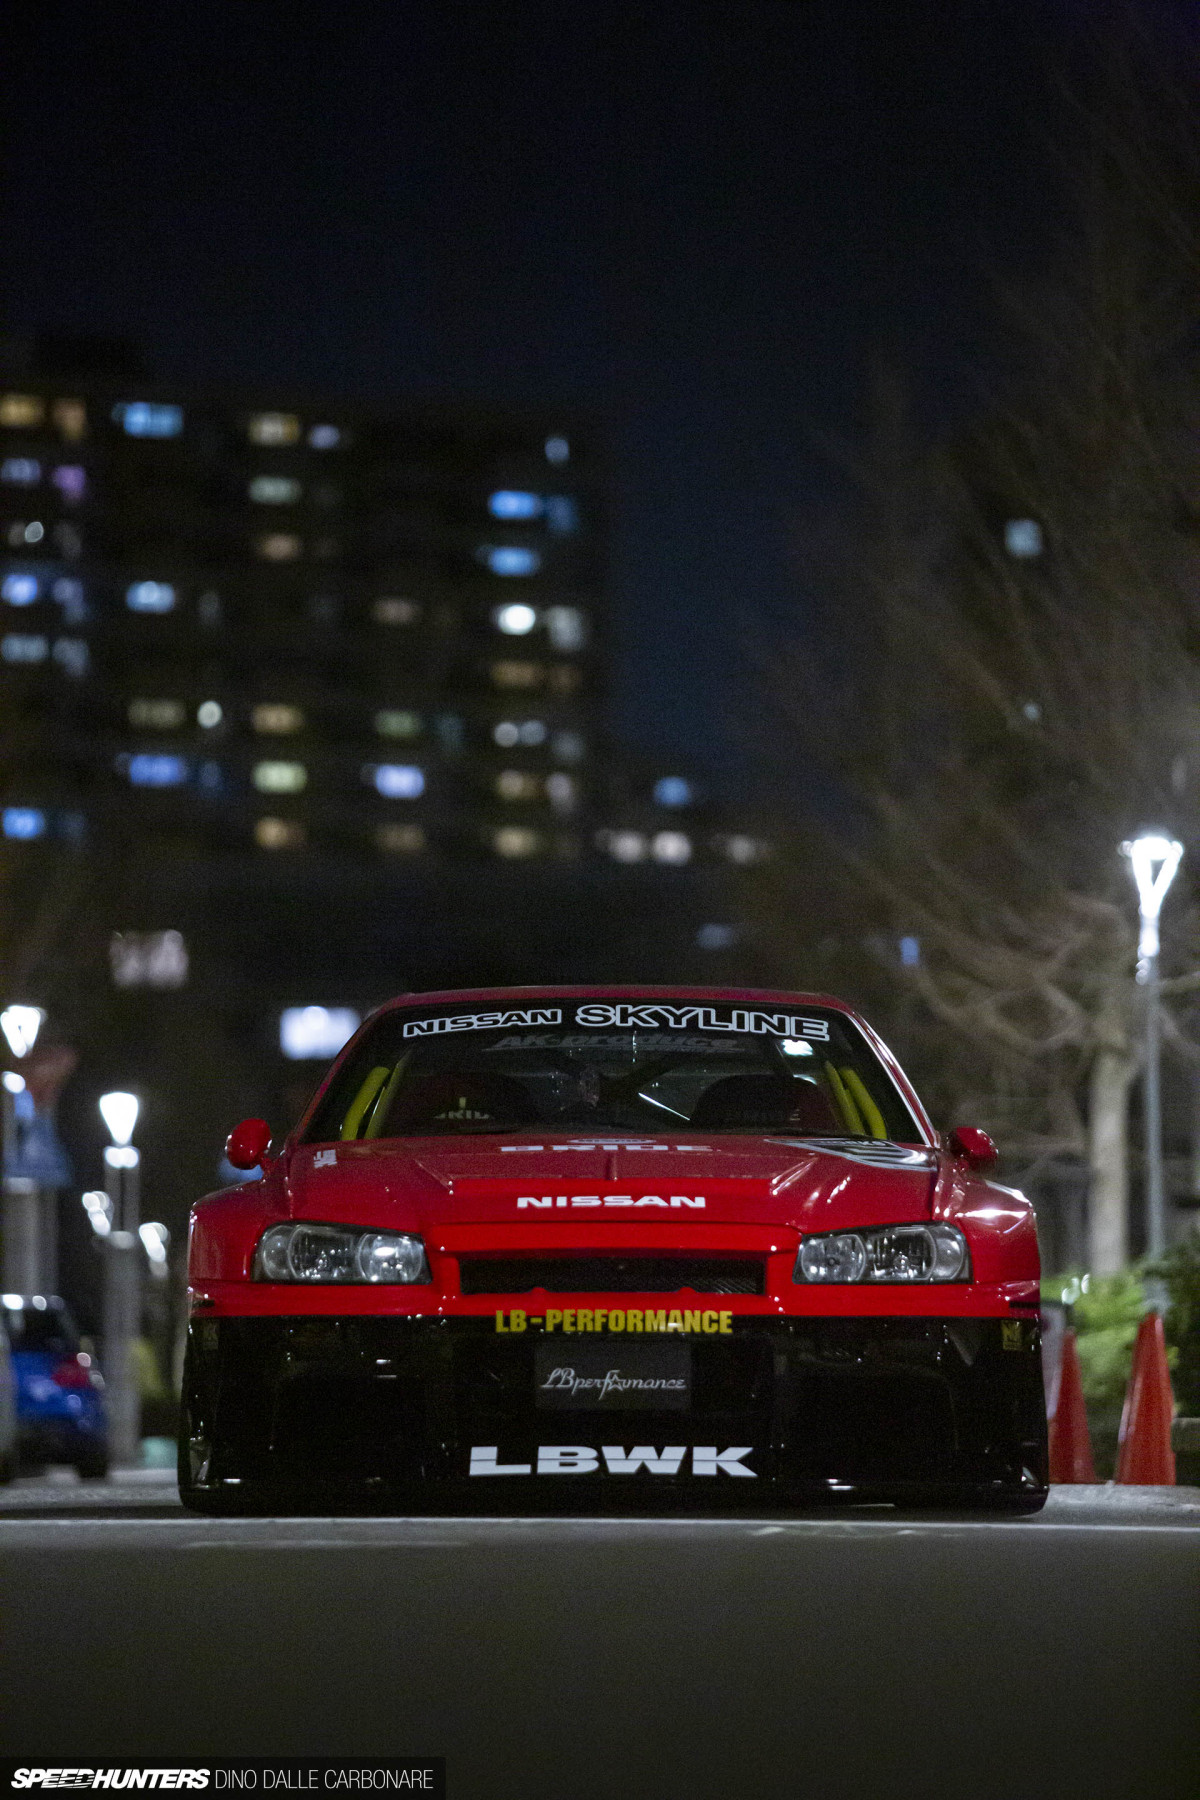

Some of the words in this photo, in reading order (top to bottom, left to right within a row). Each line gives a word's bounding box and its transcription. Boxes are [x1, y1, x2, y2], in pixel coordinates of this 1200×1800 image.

[402, 1009, 561, 1038] NISSAN
[574, 1004, 830, 1042] SKYLINE
[516, 1196, 706, 1208] NISSAN
[469, 1446, 758, 1477] LBWK
